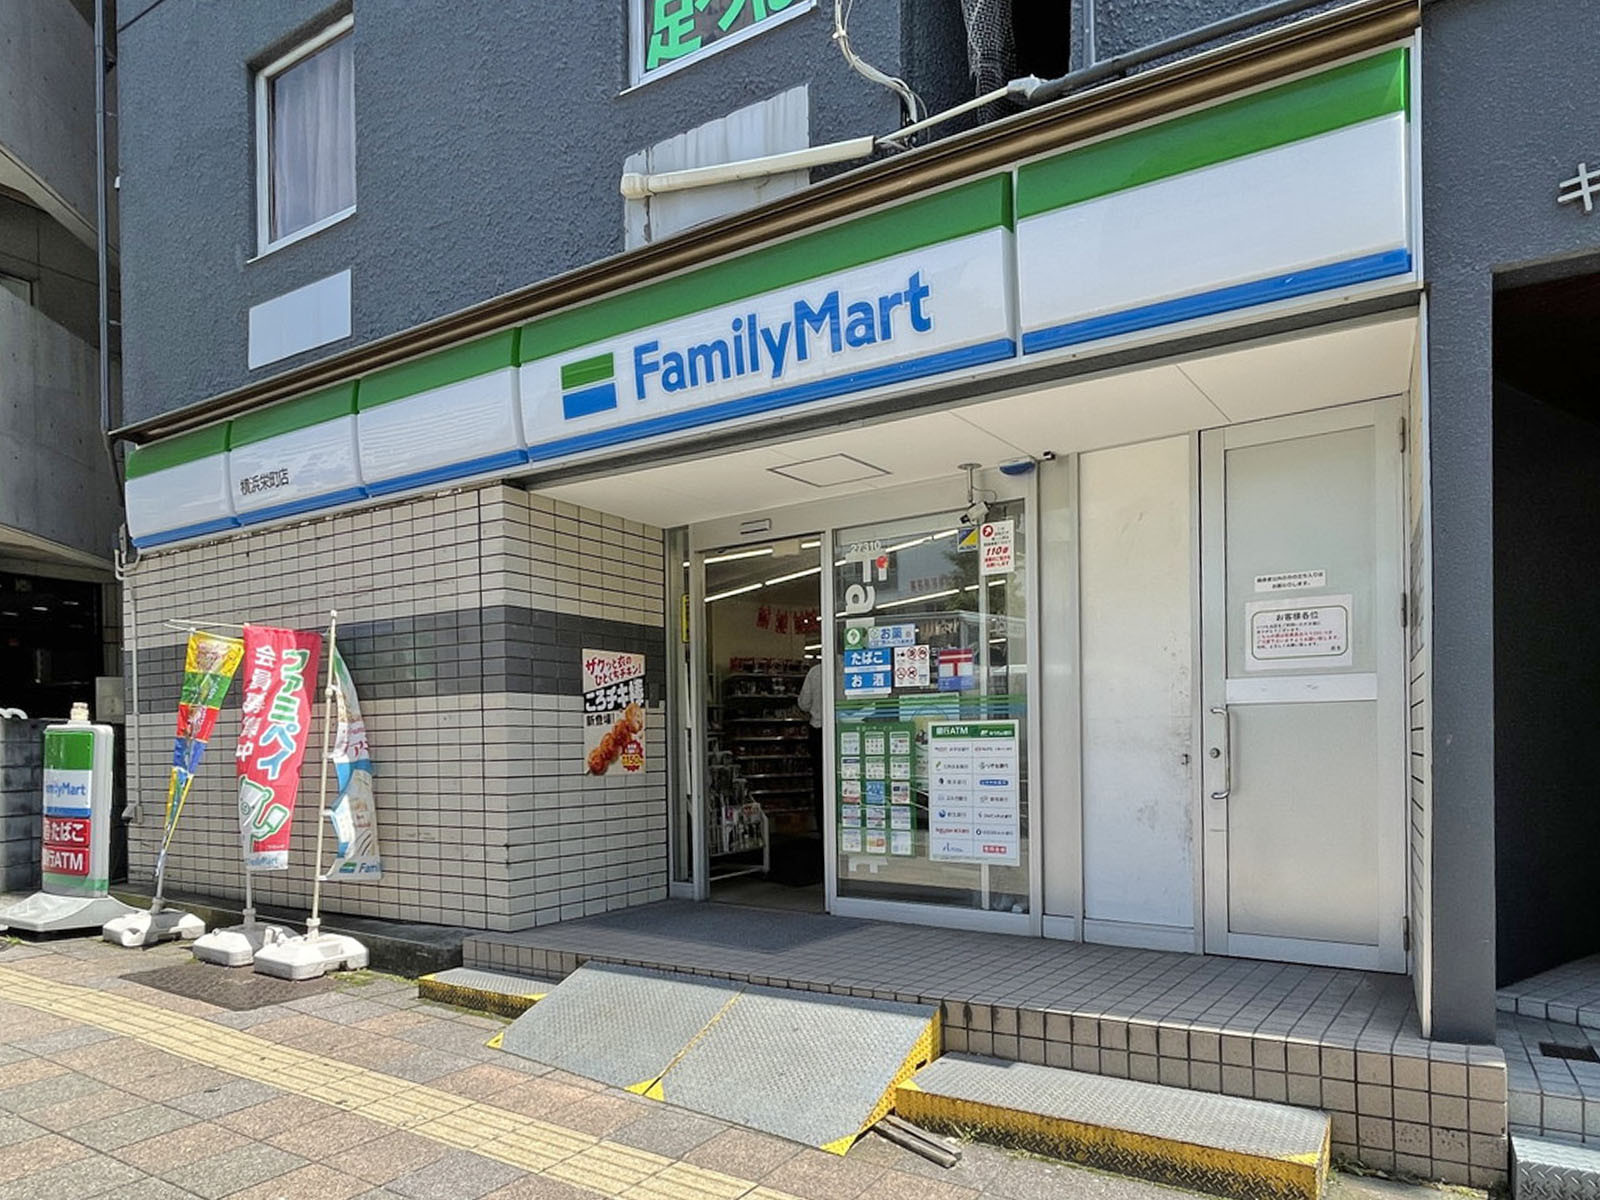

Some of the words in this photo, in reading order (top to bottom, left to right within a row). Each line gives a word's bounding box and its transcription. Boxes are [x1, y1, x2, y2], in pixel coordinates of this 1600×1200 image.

[633, 271, 932, 400] FamilyMart
[235, 644, 277, 763] 会員募集中
[257, 649, 311, 781] ファミペイ
[851, 651, 883, 666] たばこ
